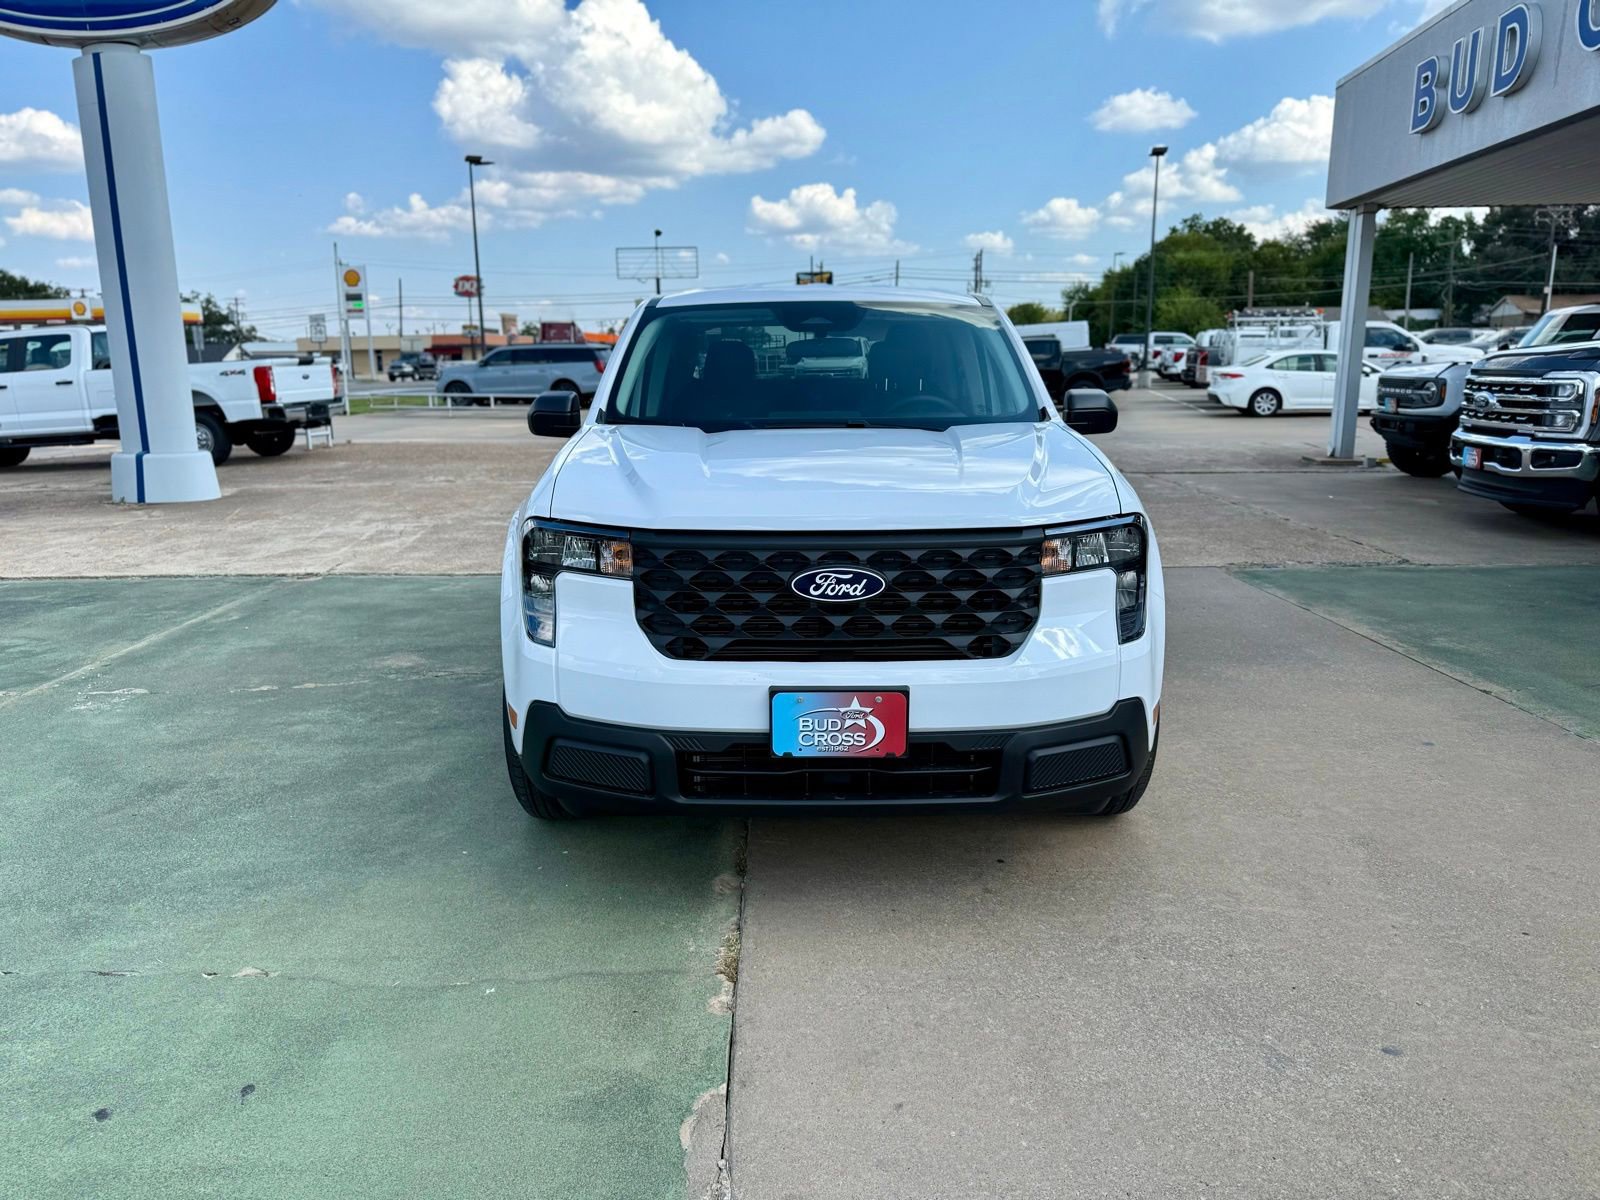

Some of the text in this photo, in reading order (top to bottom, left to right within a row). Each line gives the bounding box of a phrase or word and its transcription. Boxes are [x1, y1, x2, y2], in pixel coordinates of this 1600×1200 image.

[1408, 3, 1538, 135] BUD
[809, 572, 867, 596] Ford
[845, 711, 865, 719] Ford
[799, 717, 842, 731] BUD
[798, 732, 866, 746] CROSS
